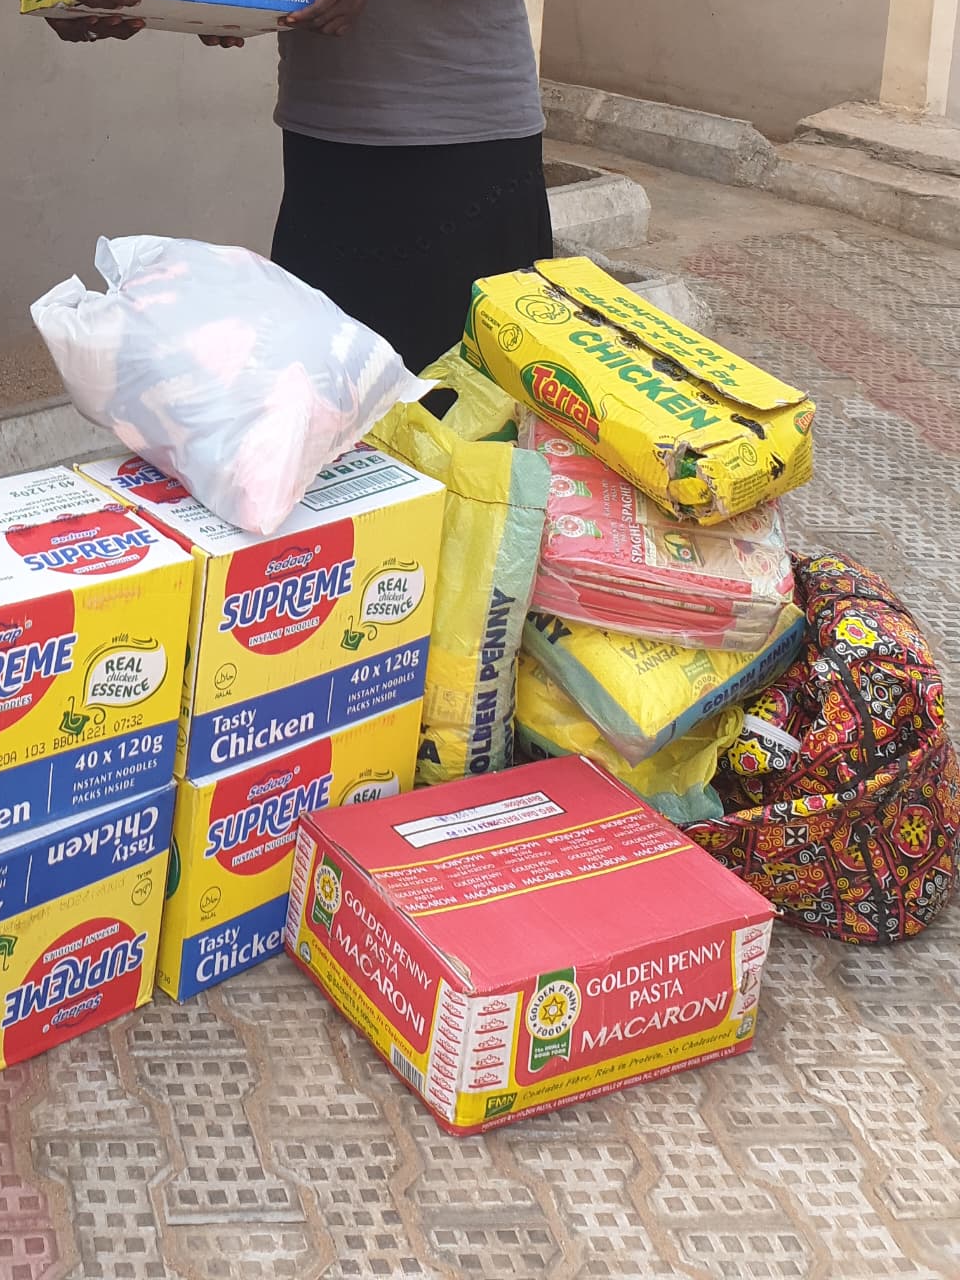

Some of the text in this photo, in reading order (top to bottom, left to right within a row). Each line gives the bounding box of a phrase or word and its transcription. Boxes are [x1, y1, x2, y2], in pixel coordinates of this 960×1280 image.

[574, 286, 695, 357] 25 strips
[613, 296, 723, 362] 10 pouches
[533, 364, 590, 427] Terra
[568, 330, 722, 430] CHICKEN
[620, 483, 633, 522] SPAGHE
[24, 530, 158, 571] SUPREME
[630, 522, 643, 563] SPAGHE
[266, 550, 312, 575] Sedaap
[218, 560, 356, 632] SUPREME
[377, 577, 408, 595] REAL
[378, 590, 406, 602] chicken
[366, 596, 414, 616] ESSENCE
[248, 616, 320, 647] INSTANT NOODLES
[105, 656, 143, 676] REAL
[106, 670, 138, 683] chicken
[350, 649, 420, 685] 40 x 120g
[638, 646, 680, 675] PENNY
[91, 678, 150, 698] ESSENCE
[348, 671, 416, 703] INSTANT NOODLES
[469, 587, 516, 775] PENNY OLDEN
[346, 690, 397, 716] PACKS INSIDE
[114, 714, 144, 734] 07:32
[210, 712, 314, 764] Chicken
[212, 708, 256, 736] Tasty
[76, 734, 164, 772] 40 x 120g
[73, 758, 158, 792] INSTANT NOODLES
[247, 772, 292, 800] Sedaap
[72, 778, 136, 805] PACKS INSIDE
[204, 774, 333, 859] SUPREME
[48, 806, 160, 865] Chicken
[112, 834, 156, 864] Tasty
[633, 840, 682, 857] MACARONI
[232, 845, 263, 867] INSTANT
[578, 855, 628, 872] MACARONI
[464, 882, 516, 900] MACARONI
[522, 869, 572, 886] MACARONI
[405, 896, 458, 912] MACARONI
[43, 922, 120, 963] INSTANT NOODLES
[198, 926, 240, 955] Tasty
[344, 890, 392, 947] GOLDEN
[392, 940, 433, 990] PENNY
[366, 934, 399, 980] PASTA
[586, 940, 726, 996] GOLDEN PENNY
[2, 932, 148, 1028] SUPREME
[336, 924, 426, 1036] MACARONI
[630, 978, 684, 1010] PASTA
[52, 992, 103, 1026] Sedaap
[530, 984, 577, 1021] GOLDEN PENNY
[537, 1022, 568, 1037] FOODS
[581, 991, 728, 1053] MACARONI
[682, 1030, 732, 1052] Cholesterol
[488, 1094, 516, 1109] FMN
